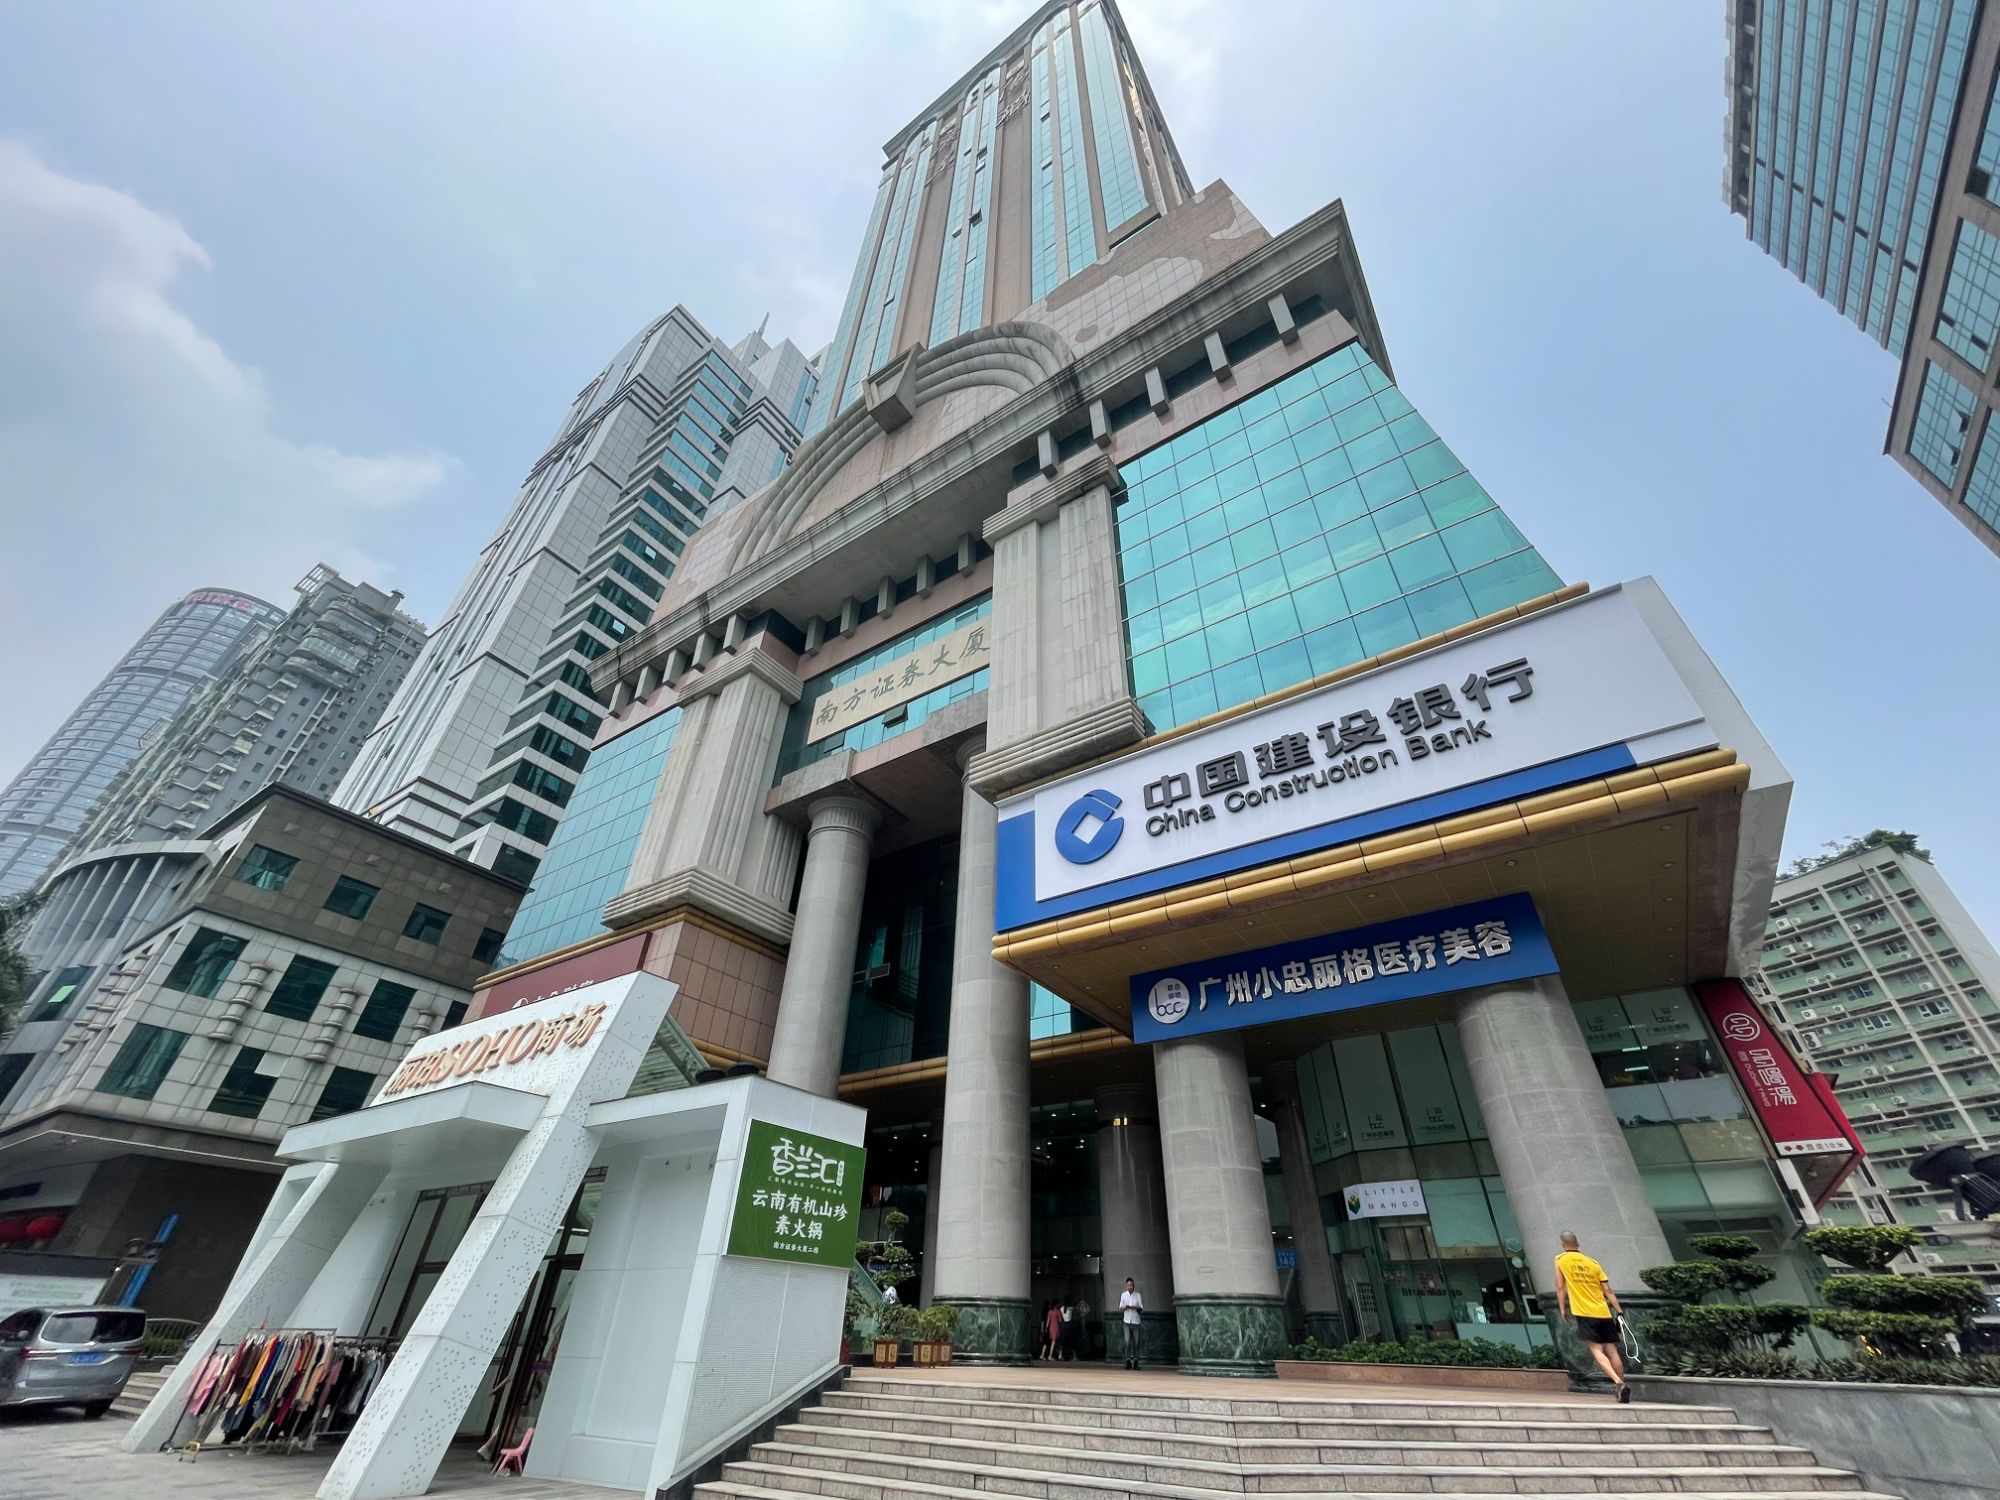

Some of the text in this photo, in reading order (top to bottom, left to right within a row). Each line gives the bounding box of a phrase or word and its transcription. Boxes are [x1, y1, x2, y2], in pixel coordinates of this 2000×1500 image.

[816, 626, 990, 725] 南方证券大厦
[1143, 657, 1534, 810] 中国建设银行
[1145, 719, 1492, 836] China Construction Bank
[1198, 920, 1513, 1011] 广州小忠丽格医疗美容
[770, 1137, 837, 1184] 香兰汇
[752, 1189, 848, 1222] 云南有机山珍
[1364, 1186, 1415, 1197] LITTLE
[1368, 1200, 1420, 1211] MANGO
[774, 1214, 823, 1240] 素火锅
[1279, 1256, 1295, 1266] 140
